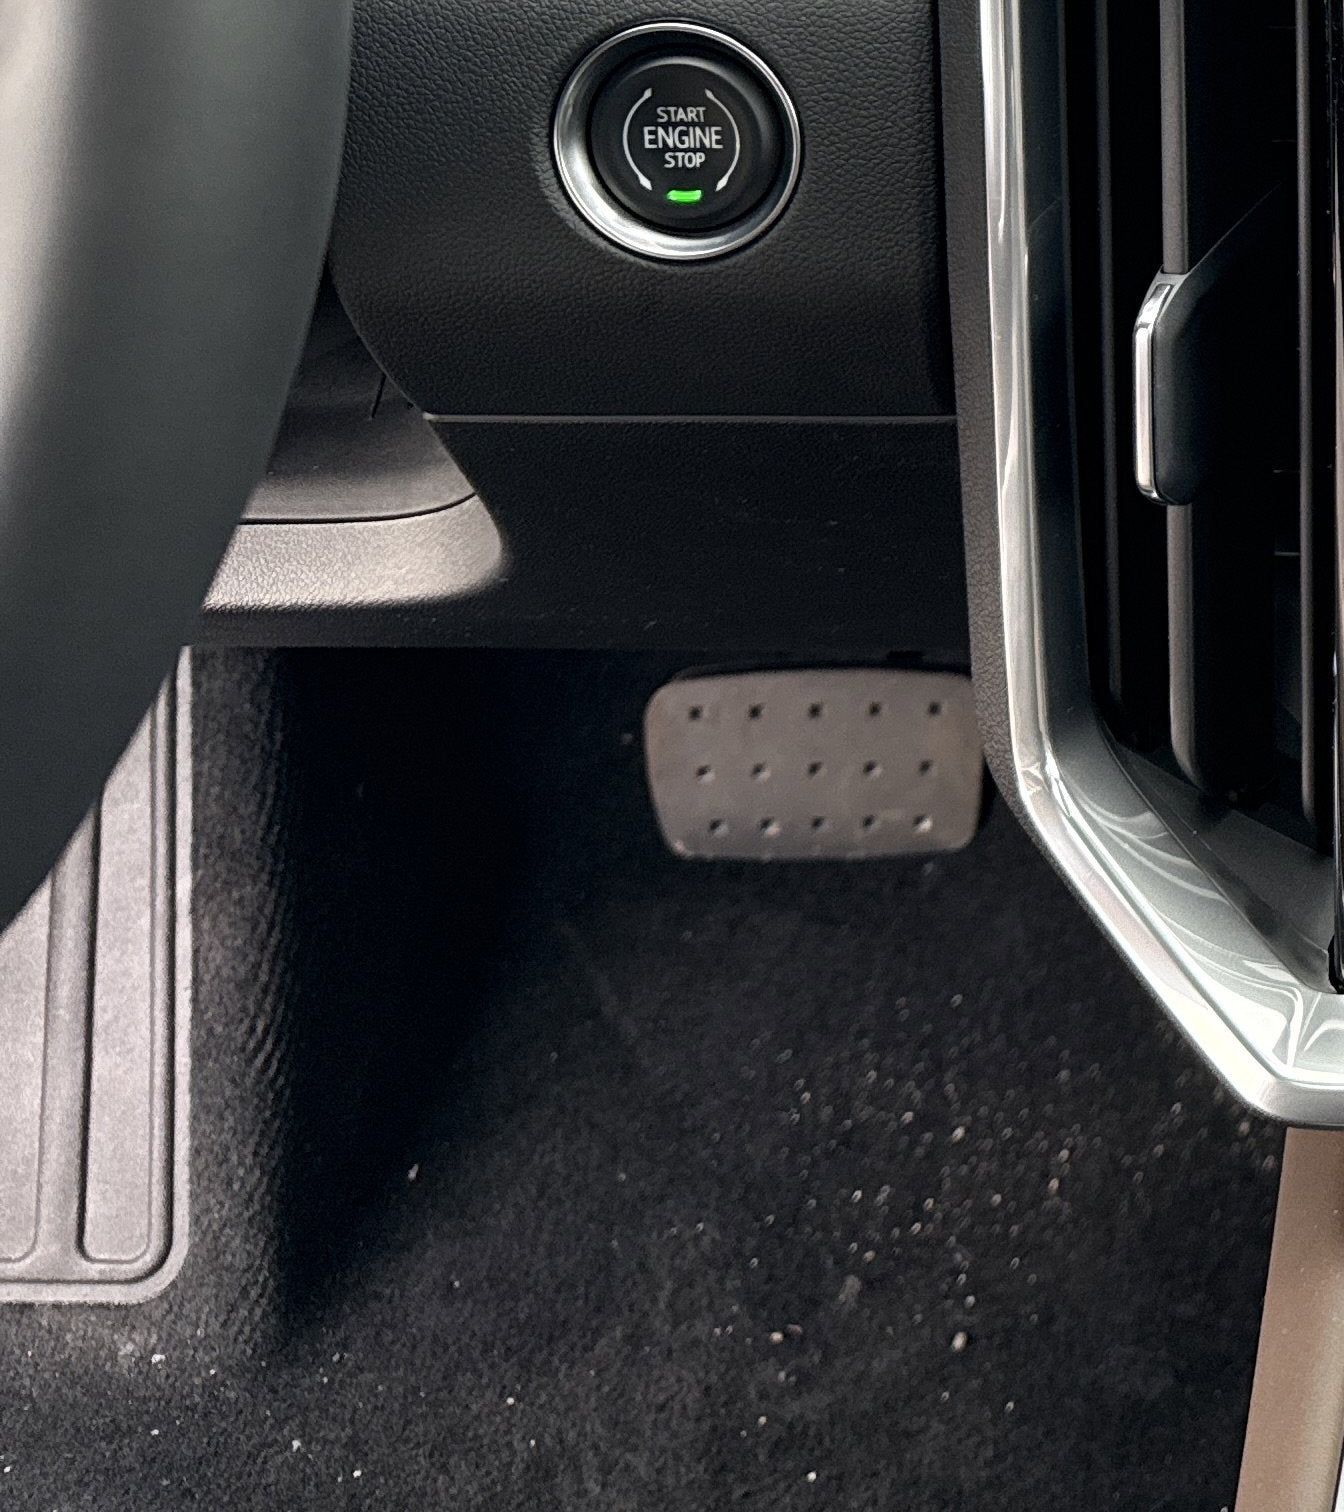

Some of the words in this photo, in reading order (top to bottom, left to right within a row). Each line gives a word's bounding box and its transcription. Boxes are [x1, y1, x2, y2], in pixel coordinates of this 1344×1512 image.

[656, 106, 706, 122] START
[643, 126, 723, 149] ENGINE
[664, 152, 705, 168] STOP
